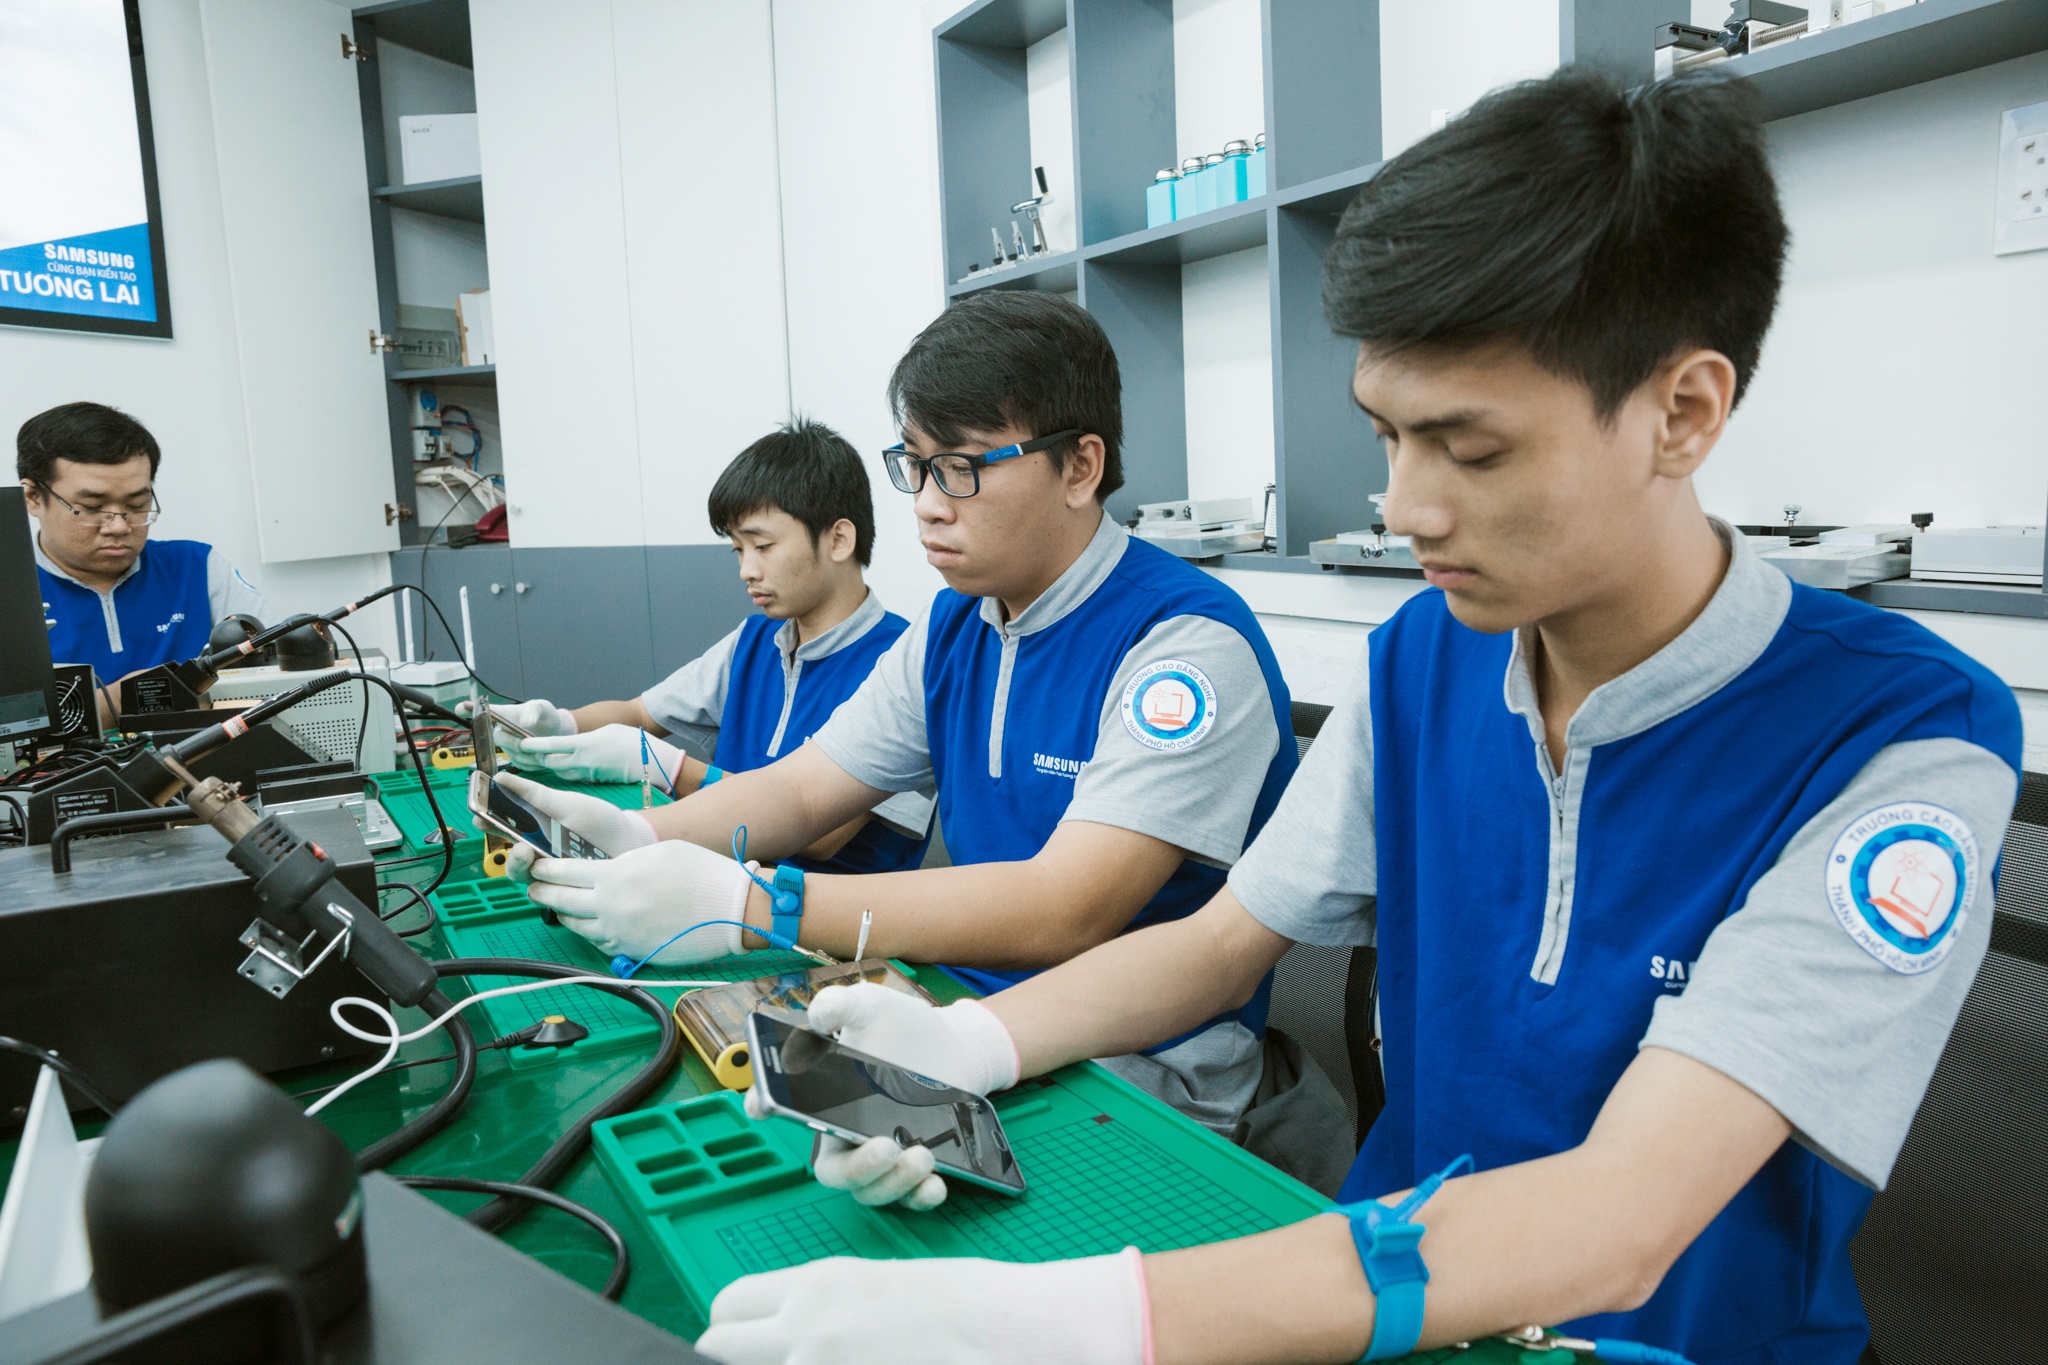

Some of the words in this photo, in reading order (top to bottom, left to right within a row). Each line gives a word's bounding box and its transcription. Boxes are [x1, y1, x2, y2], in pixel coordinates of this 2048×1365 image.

[44, 243, 135, 269] SAMSUNG
[47, 260, 75, 275] CÙNG
[75, 265, 96, 279] BẠN
[97, 267, 119, 280] KIẾN
[119, 270, 137, 283] TẠO
[0, 269, 94, 300] TƯƠNG
[100, 281, 140, 305] LAI
[1155, 663, 1174, 672] CAO
[1191, 725, 1208, 743] MINH
[1919, 810, 1953, 830] CAO
